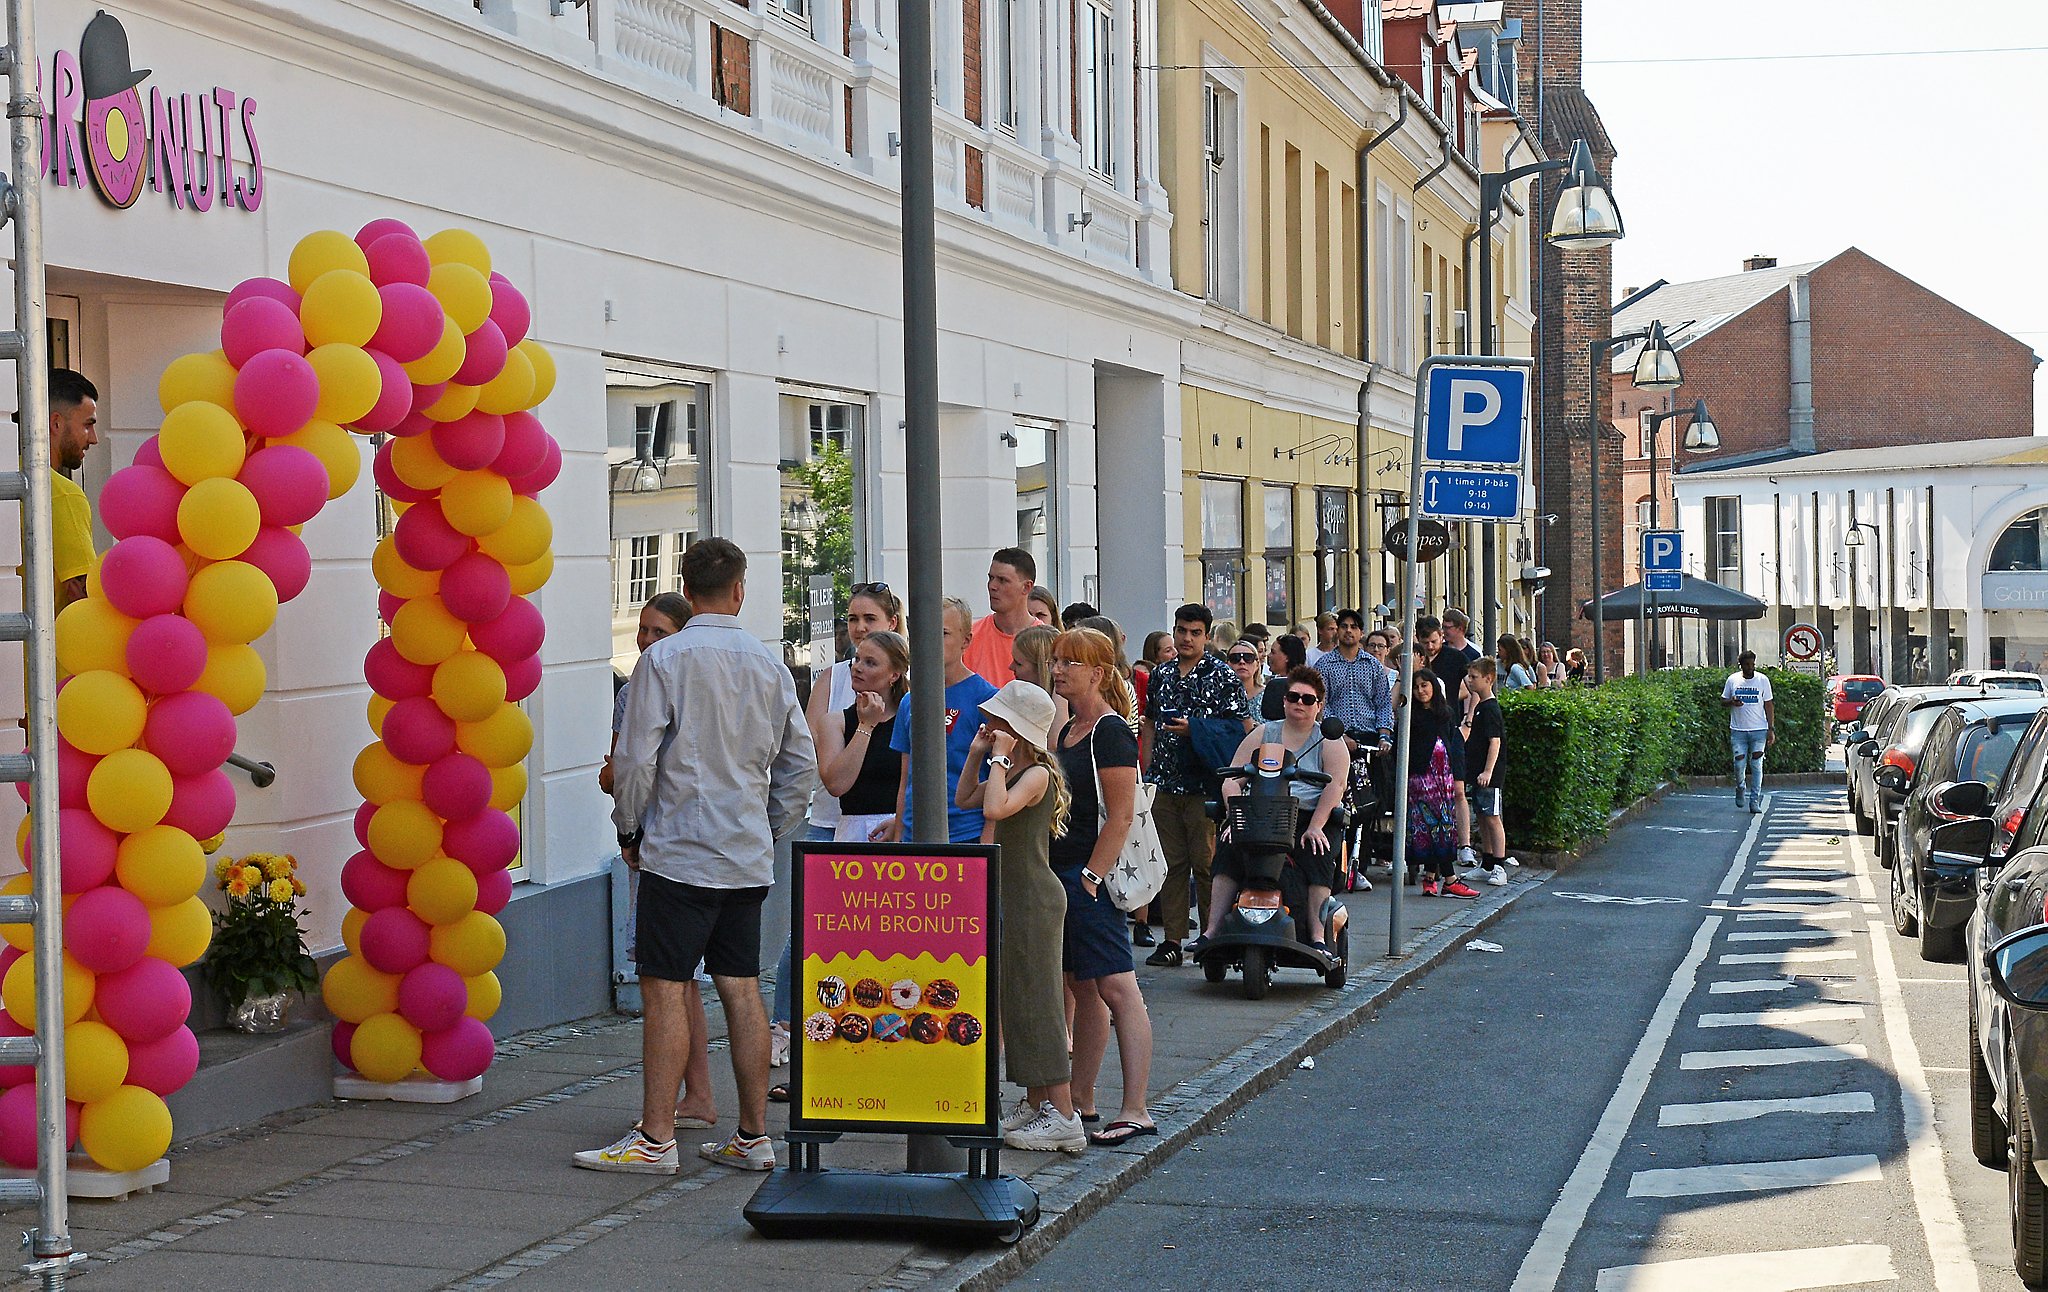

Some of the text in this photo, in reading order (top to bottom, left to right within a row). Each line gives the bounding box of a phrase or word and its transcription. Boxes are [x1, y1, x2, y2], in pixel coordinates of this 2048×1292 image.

[37, 50, 264, 213] RONUTS
[1447, 378, 1502, 452] P
[1455, 477, 1475, 486] time
[1653, 538, 1673, 566] P
[1680, 605, 1700, 615] BEER
[830, 861, 964, 883] YO YO YO !
[842, 891, 952, 911] WHATS UP
[813, 913, 981, 935] TEAM BRONUTS
[810, 1096, 843, 1110] MAN
[856, 1096, 887, 1111] SØN
[935, 1099, 951, 1113] 10
[963, 1100, 979, 1114] 21
